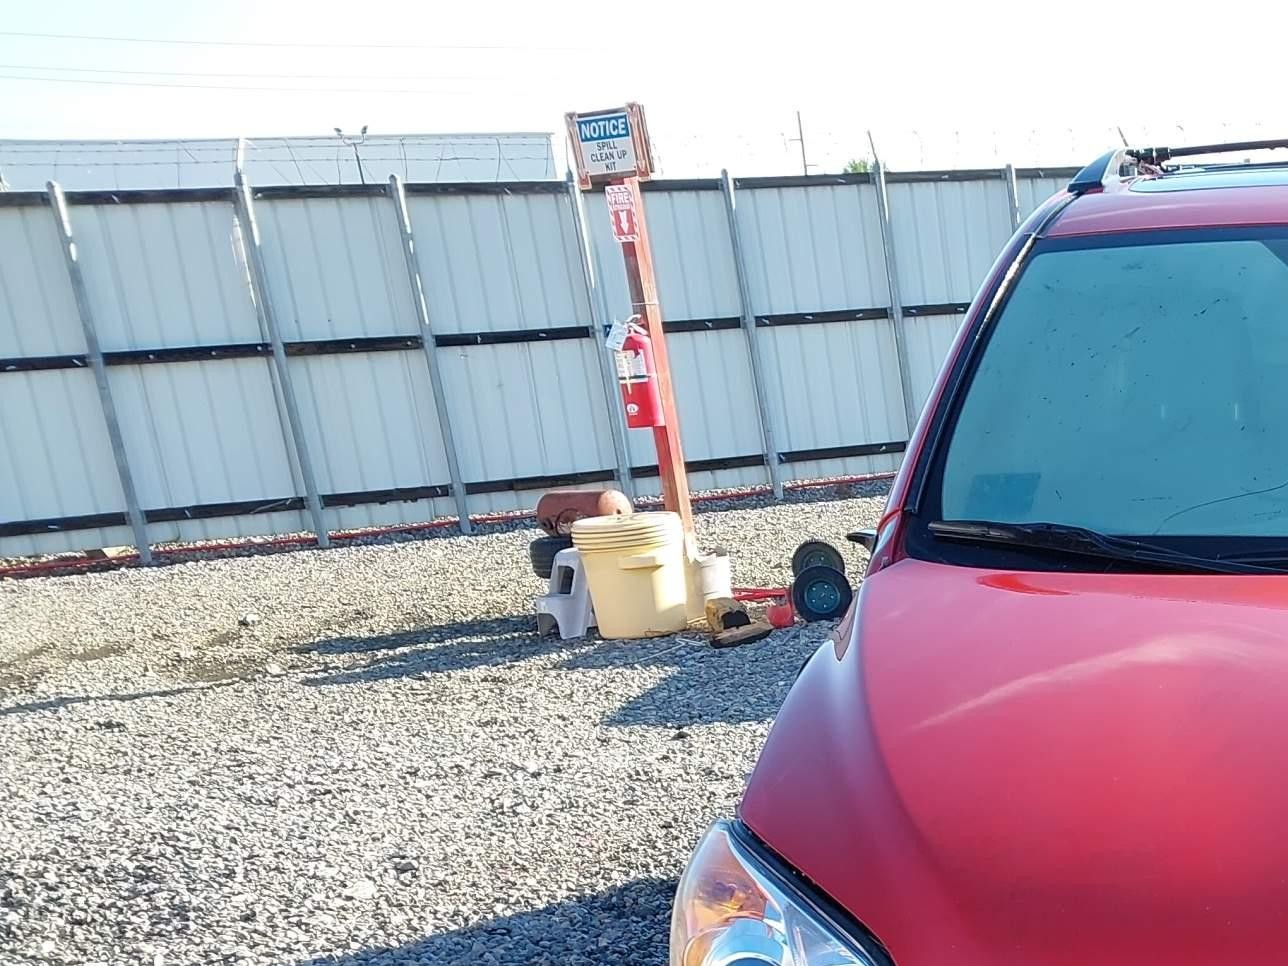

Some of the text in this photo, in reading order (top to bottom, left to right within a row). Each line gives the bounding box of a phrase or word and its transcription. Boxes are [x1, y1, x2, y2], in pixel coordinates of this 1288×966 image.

[581, 119, 626, 139] NOTICE
[597, 141, 617, 151] SPILL
[591, 151, 627, 163] CLEAN UP
[605, 162, 616, 172] KIT
[611, 192, 630, 204] FIRE
